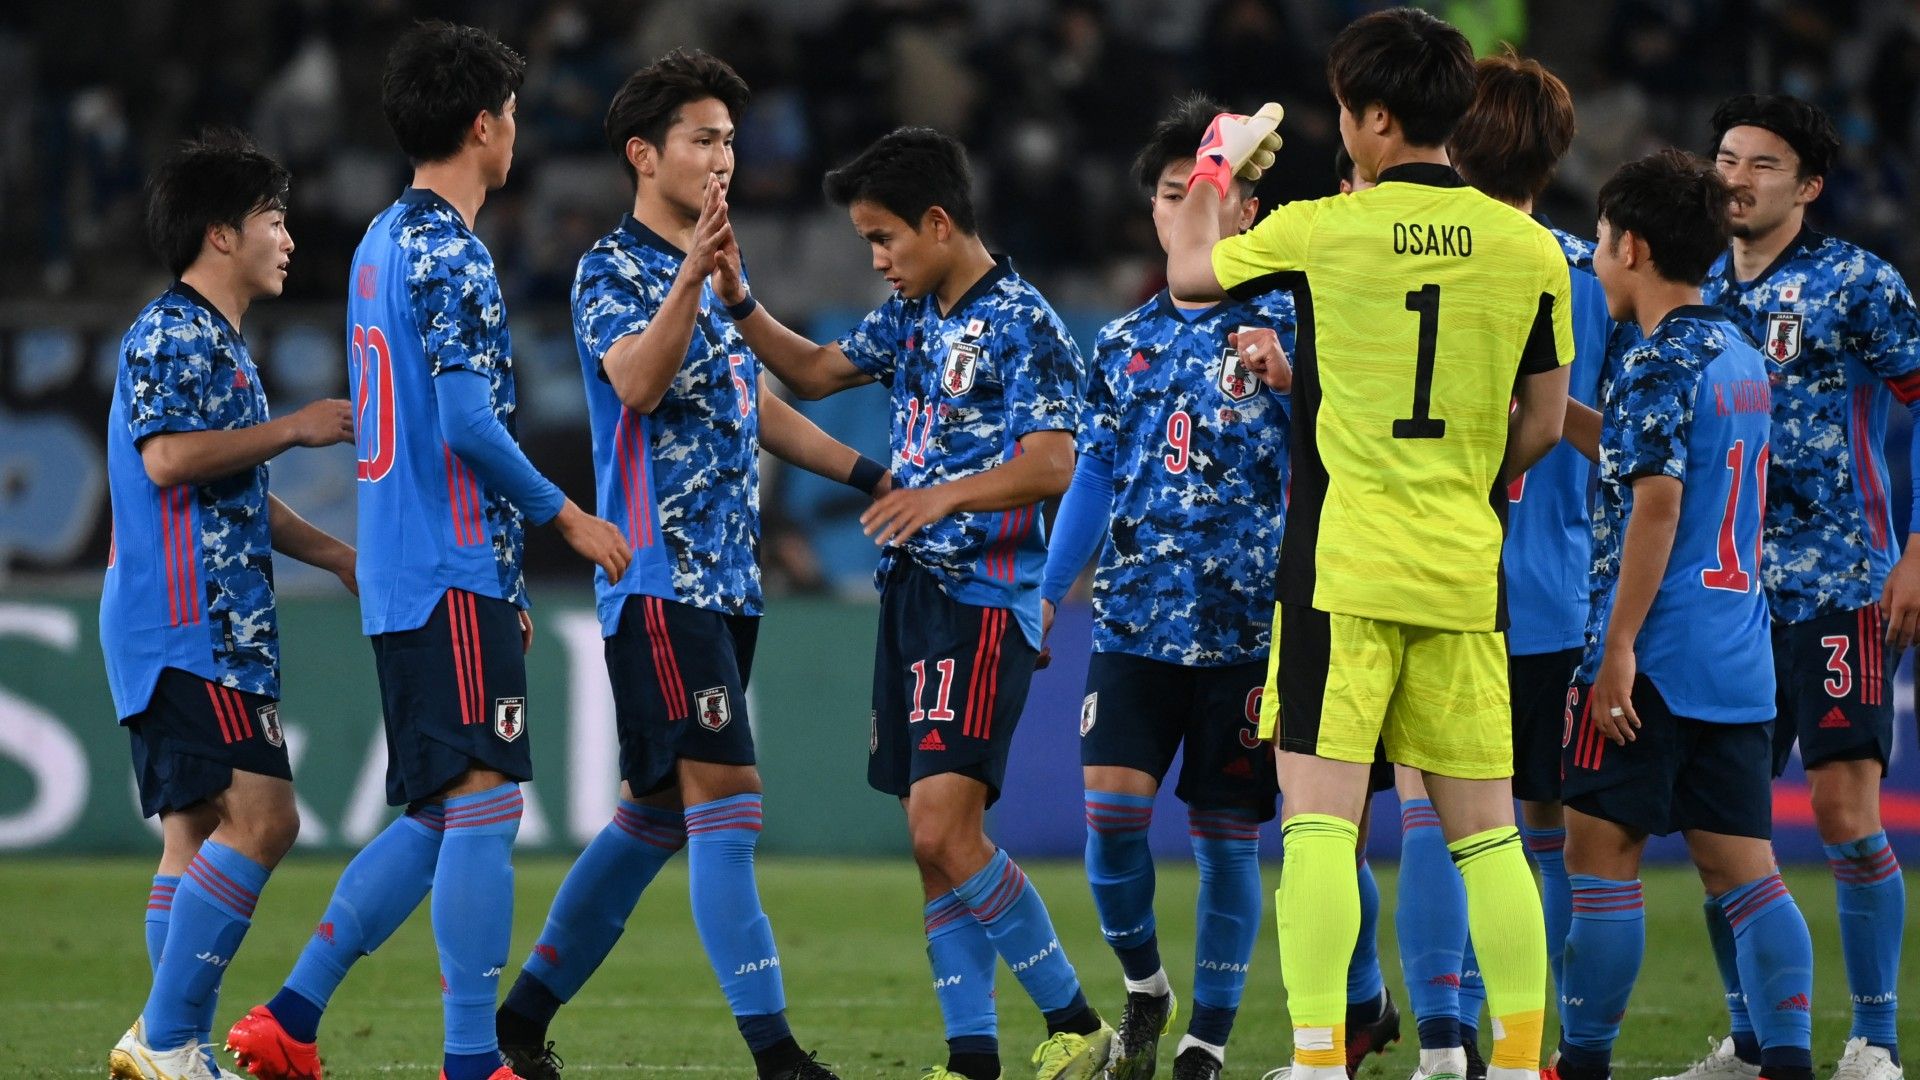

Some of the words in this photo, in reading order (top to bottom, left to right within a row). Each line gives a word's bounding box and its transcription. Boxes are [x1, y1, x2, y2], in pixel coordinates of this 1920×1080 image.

[1393, 222, 1473, 257] OSAKO
[728, 354, 750, 418] 5
[1392, 284, 1446, 439] 1
[352, 323, 396, 483] 20
[901, 397, 933, 468] 11
[1165, 410, 1191, 474] 9
[909, 658, 955, 723] 11
[1821, 635, 1852, 698] 3
[1239, 686, 1265, 749] 9
[735, 956, 779, 975] JAPA
[1012, 938, 1058, 973] JAPAN
[1198, 958, 1249, 973] JAPAN
